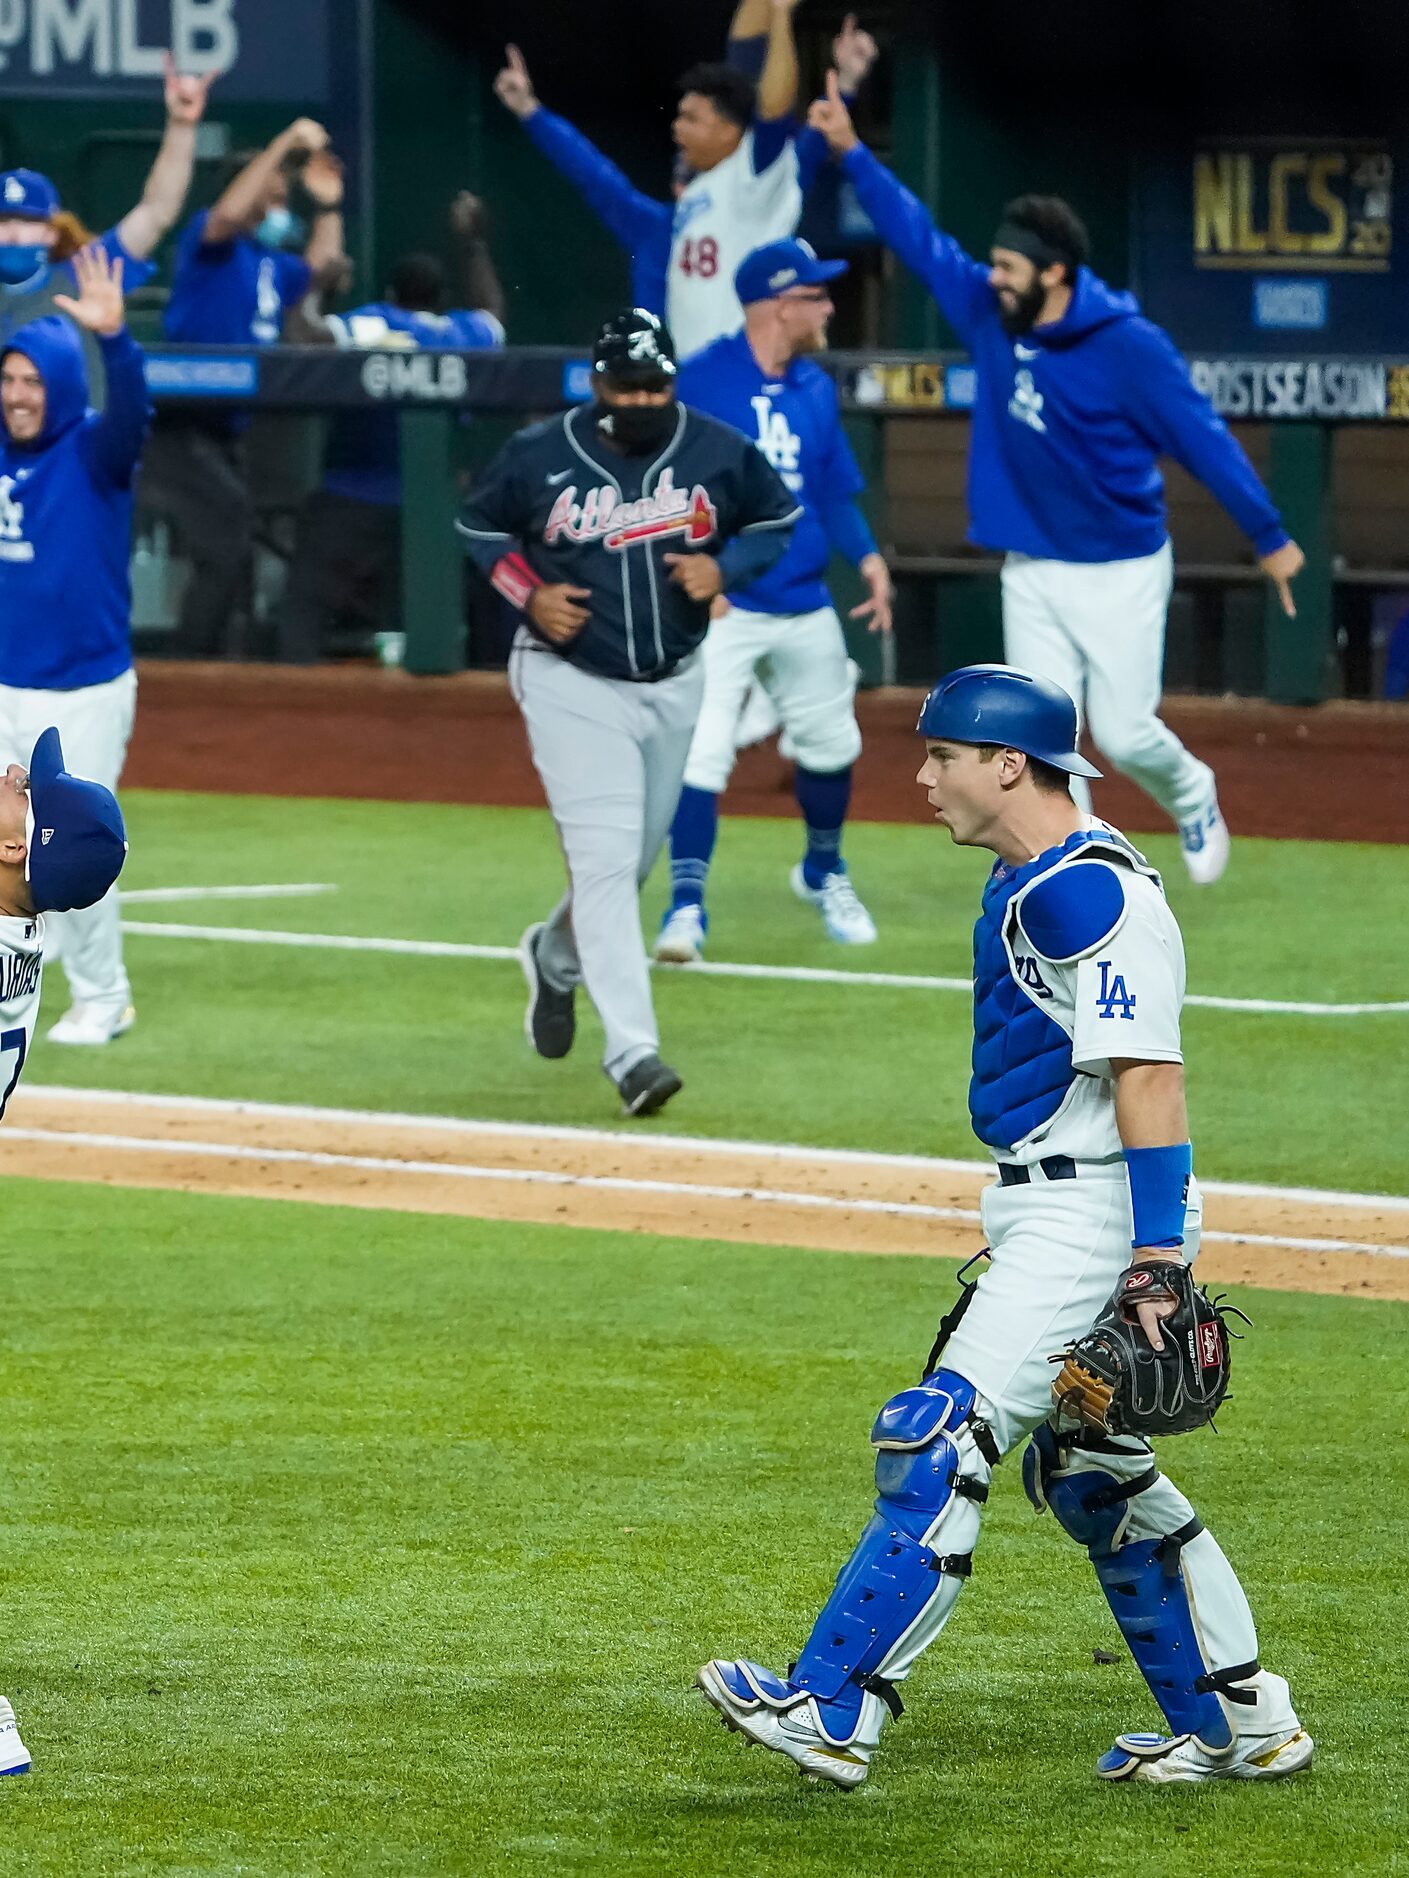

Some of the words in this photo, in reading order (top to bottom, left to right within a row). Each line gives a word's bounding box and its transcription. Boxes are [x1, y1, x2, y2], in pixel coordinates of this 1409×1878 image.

[1194, 153, 1347, 253] NLCS
[679, 235, 719, 278] 48
[361, 352, 468, 398] @MLB
[1192, 359, 1387, 418] POSTSEASON
[750, 396, 801, 472] LA
[544, 466, 690, 547] Atlanta
[1095, 960, 1137, 1021] LA
